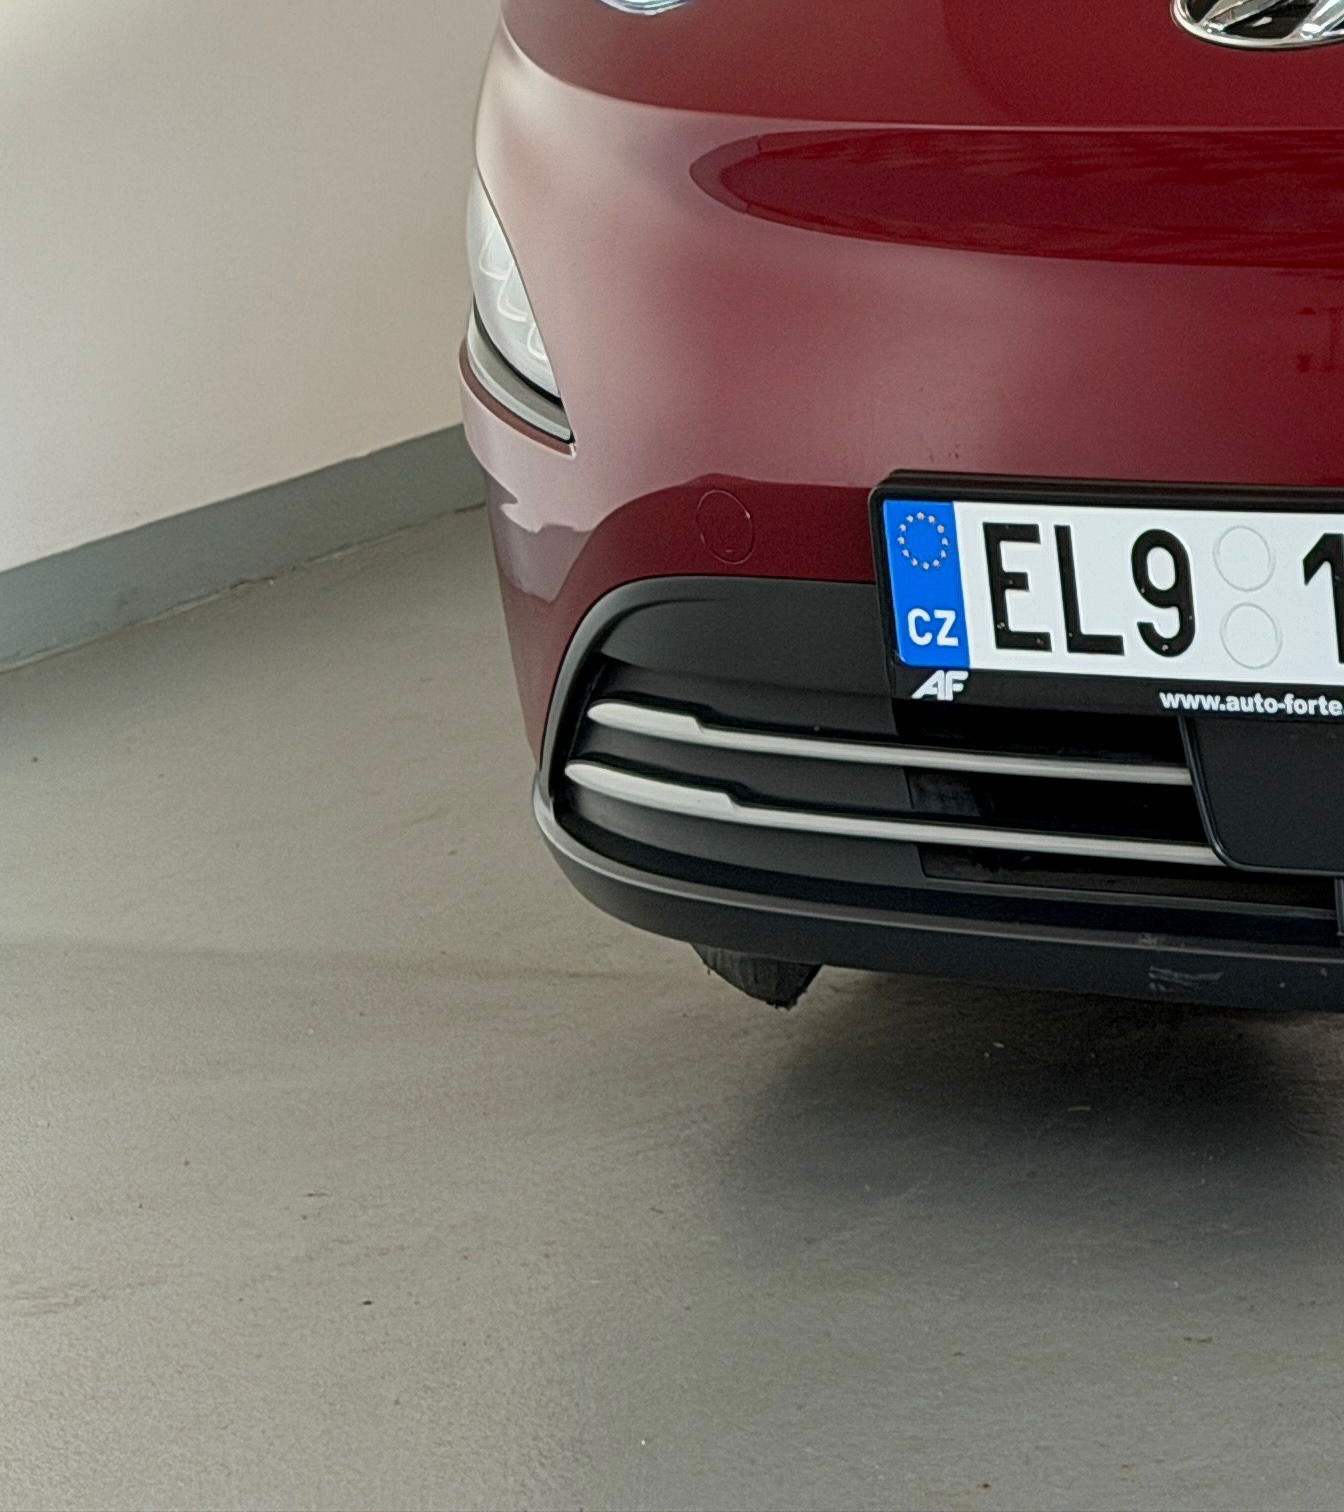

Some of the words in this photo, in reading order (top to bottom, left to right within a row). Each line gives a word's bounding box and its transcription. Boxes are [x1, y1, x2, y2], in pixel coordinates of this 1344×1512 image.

[982, 521, 1196, 658] EL9
[907, 607, 960, 647] CZ
[911, 669, 970, 701] AF
